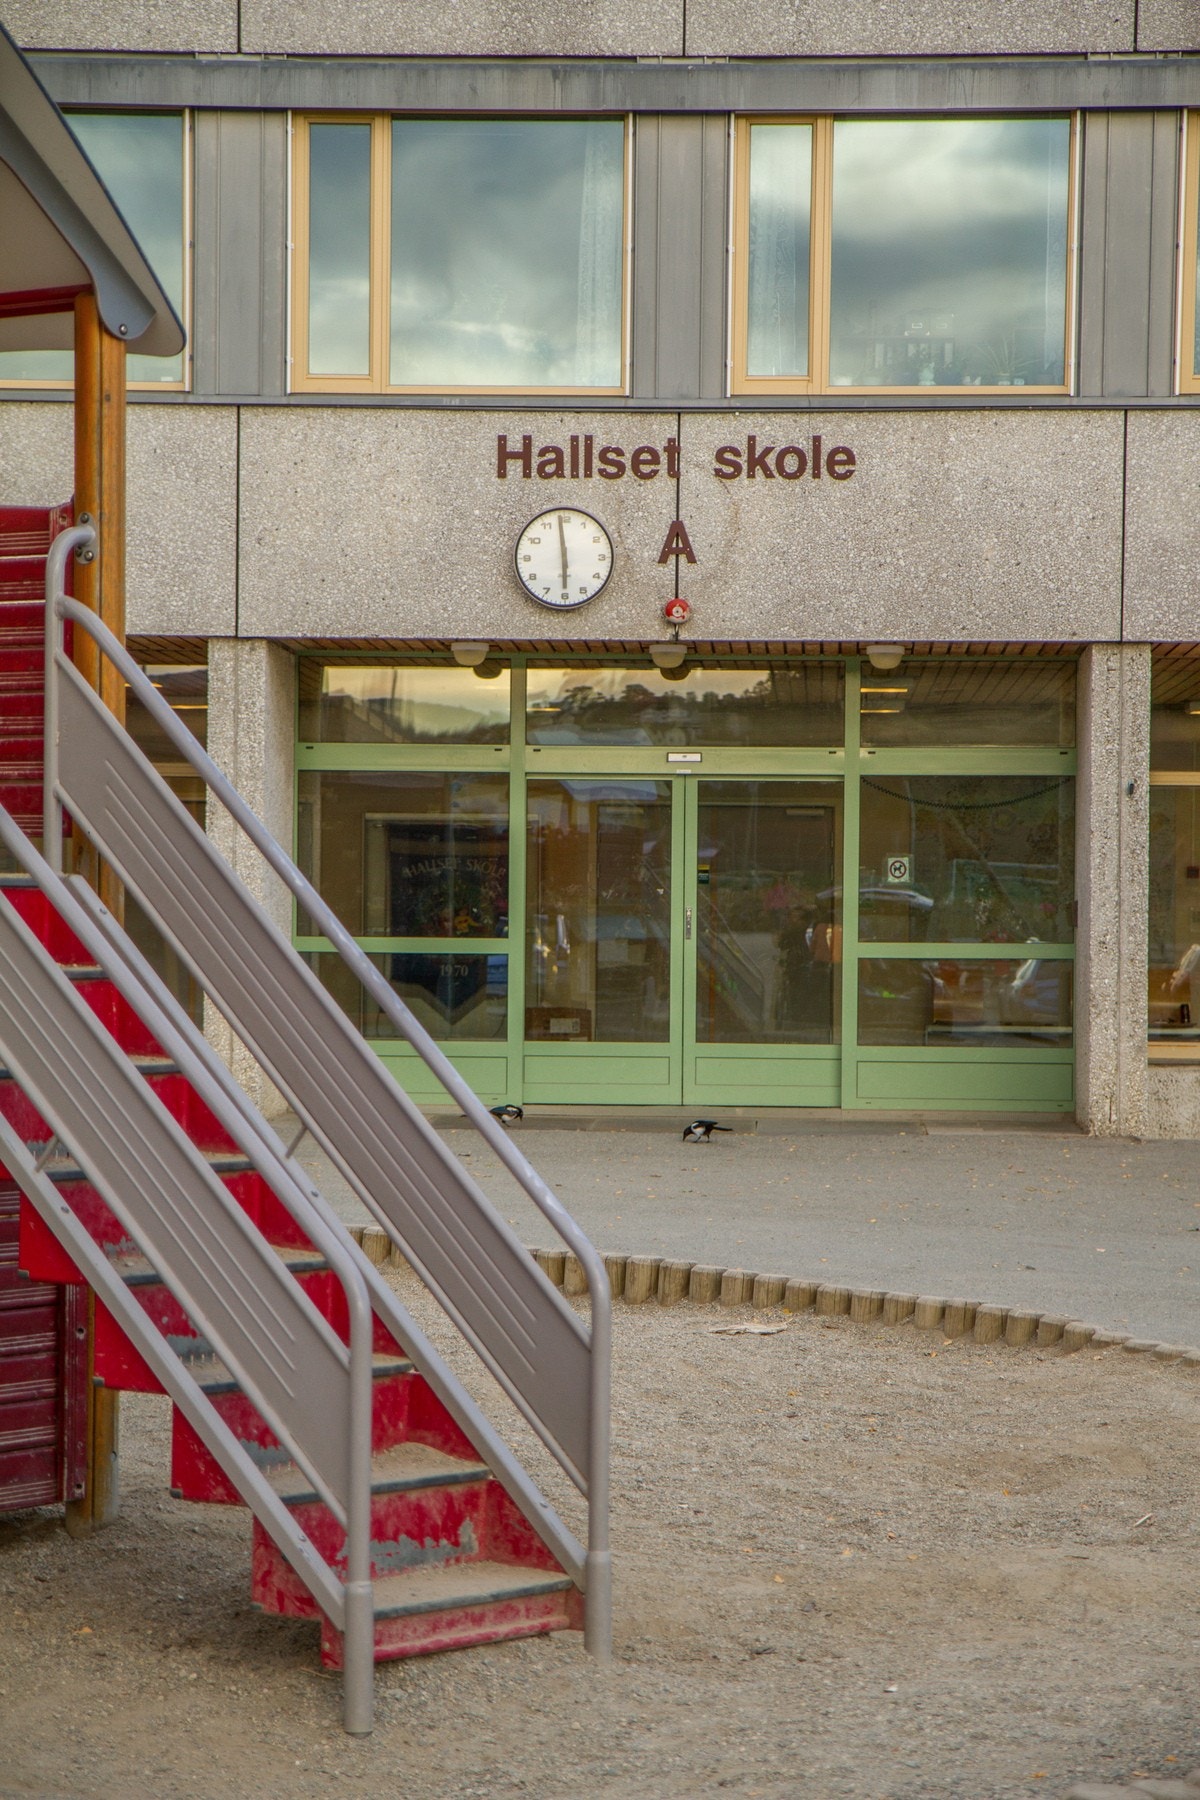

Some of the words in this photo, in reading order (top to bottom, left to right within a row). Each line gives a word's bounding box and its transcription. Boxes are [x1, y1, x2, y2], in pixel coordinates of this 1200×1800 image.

[497, 434, 681, 480] Hallset
[713, 435, 857, 480] skole
[541, 522, 552, 530] 11
[657, 520, 698, 564] A
[523, 554, 531, 562] 9
[561, 592, 569, 600] 6
[440, 964, 469, 977] 1970
